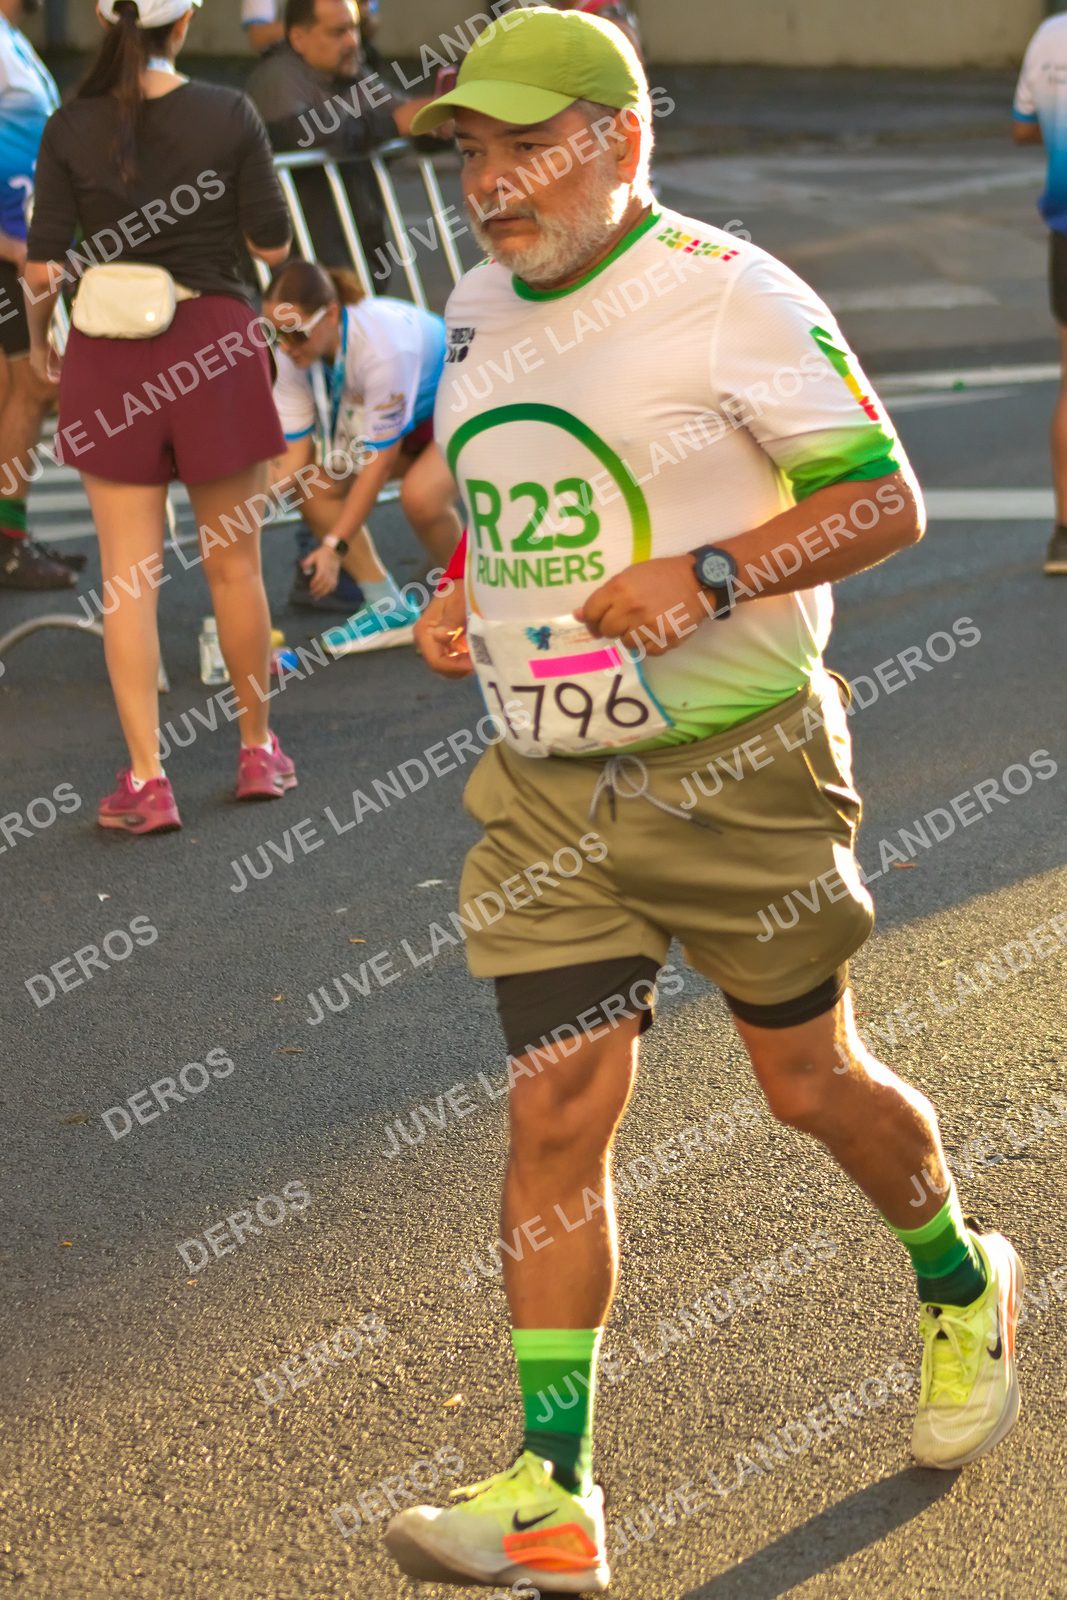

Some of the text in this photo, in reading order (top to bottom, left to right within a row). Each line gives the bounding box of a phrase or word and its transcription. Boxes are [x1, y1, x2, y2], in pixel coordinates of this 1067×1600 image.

[465, 477, 600, 552] R23
[476, 551, 605, 588] RUNNERS
[487, 674, 649, 741] 1796
